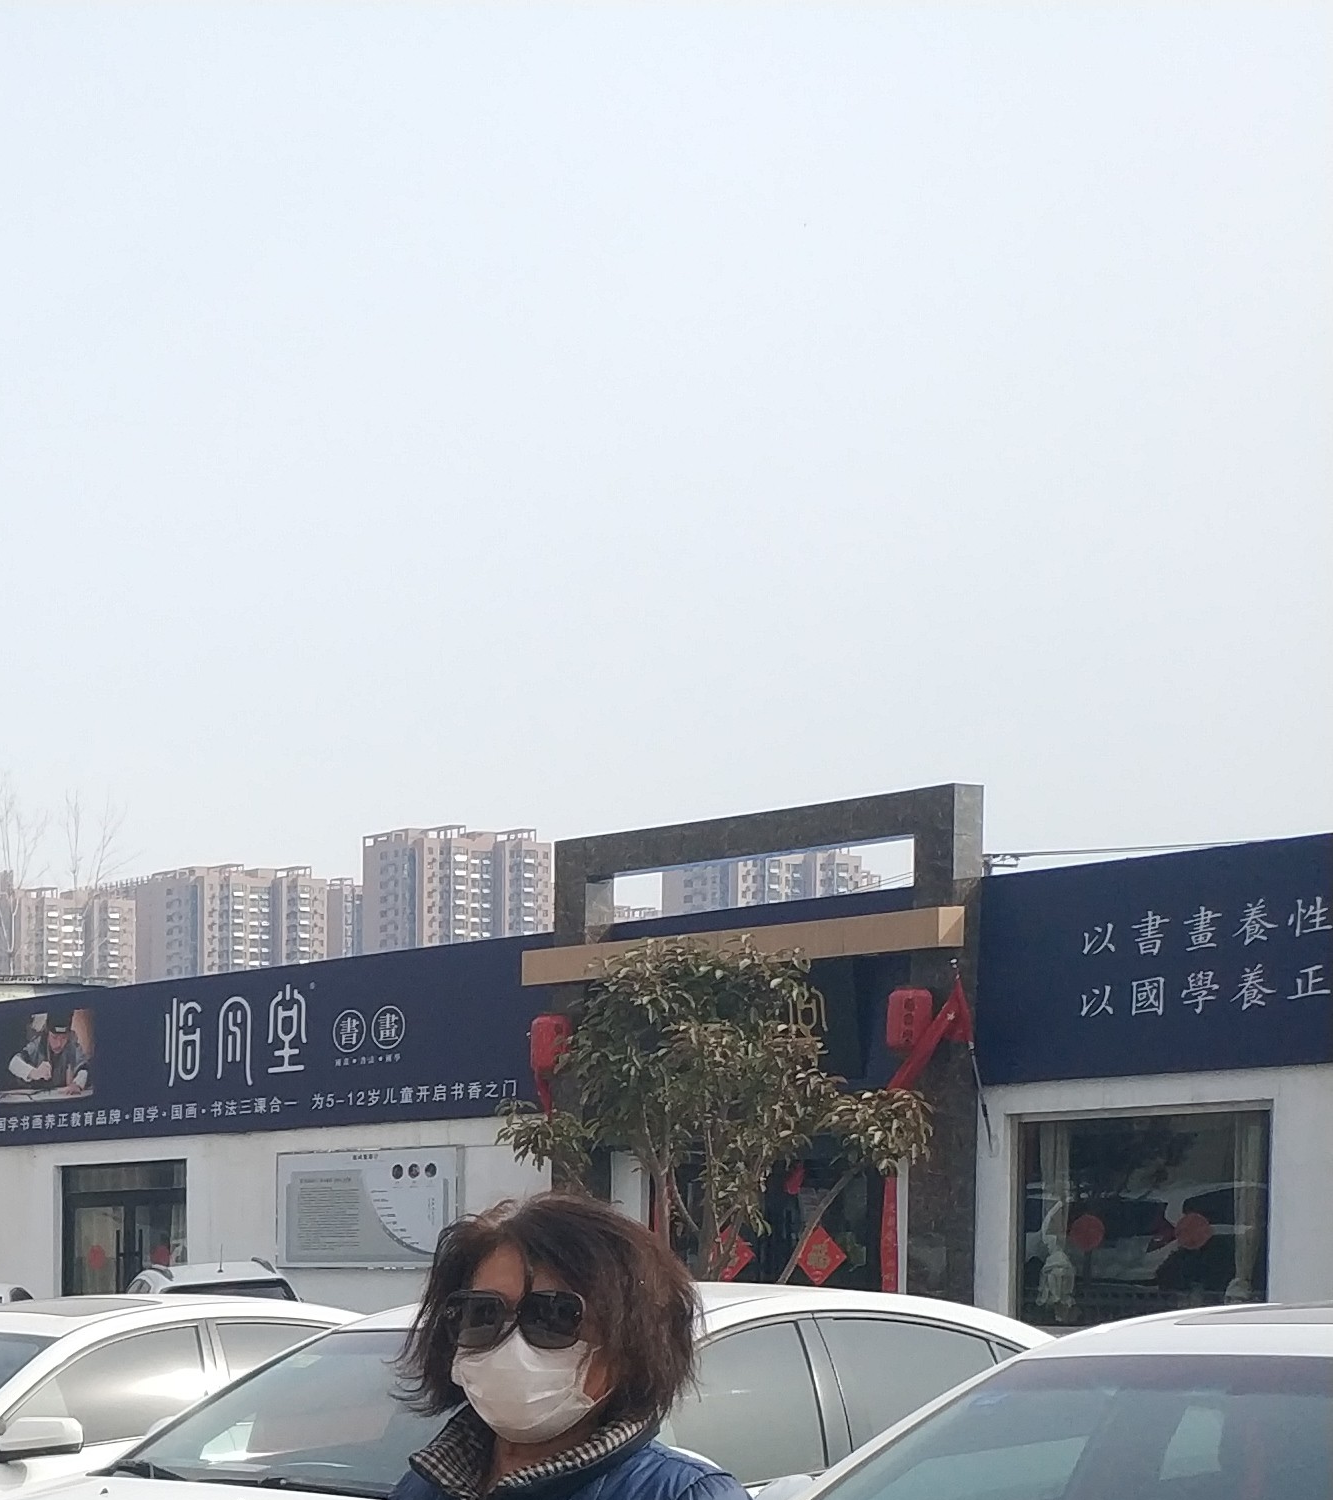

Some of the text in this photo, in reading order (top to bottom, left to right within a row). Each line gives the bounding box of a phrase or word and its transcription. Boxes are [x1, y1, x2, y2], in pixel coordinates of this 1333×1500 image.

[1082, 896, 1333, 955] 以書畫養性
[1080, 963, 1332, 1017] 以國學養正
